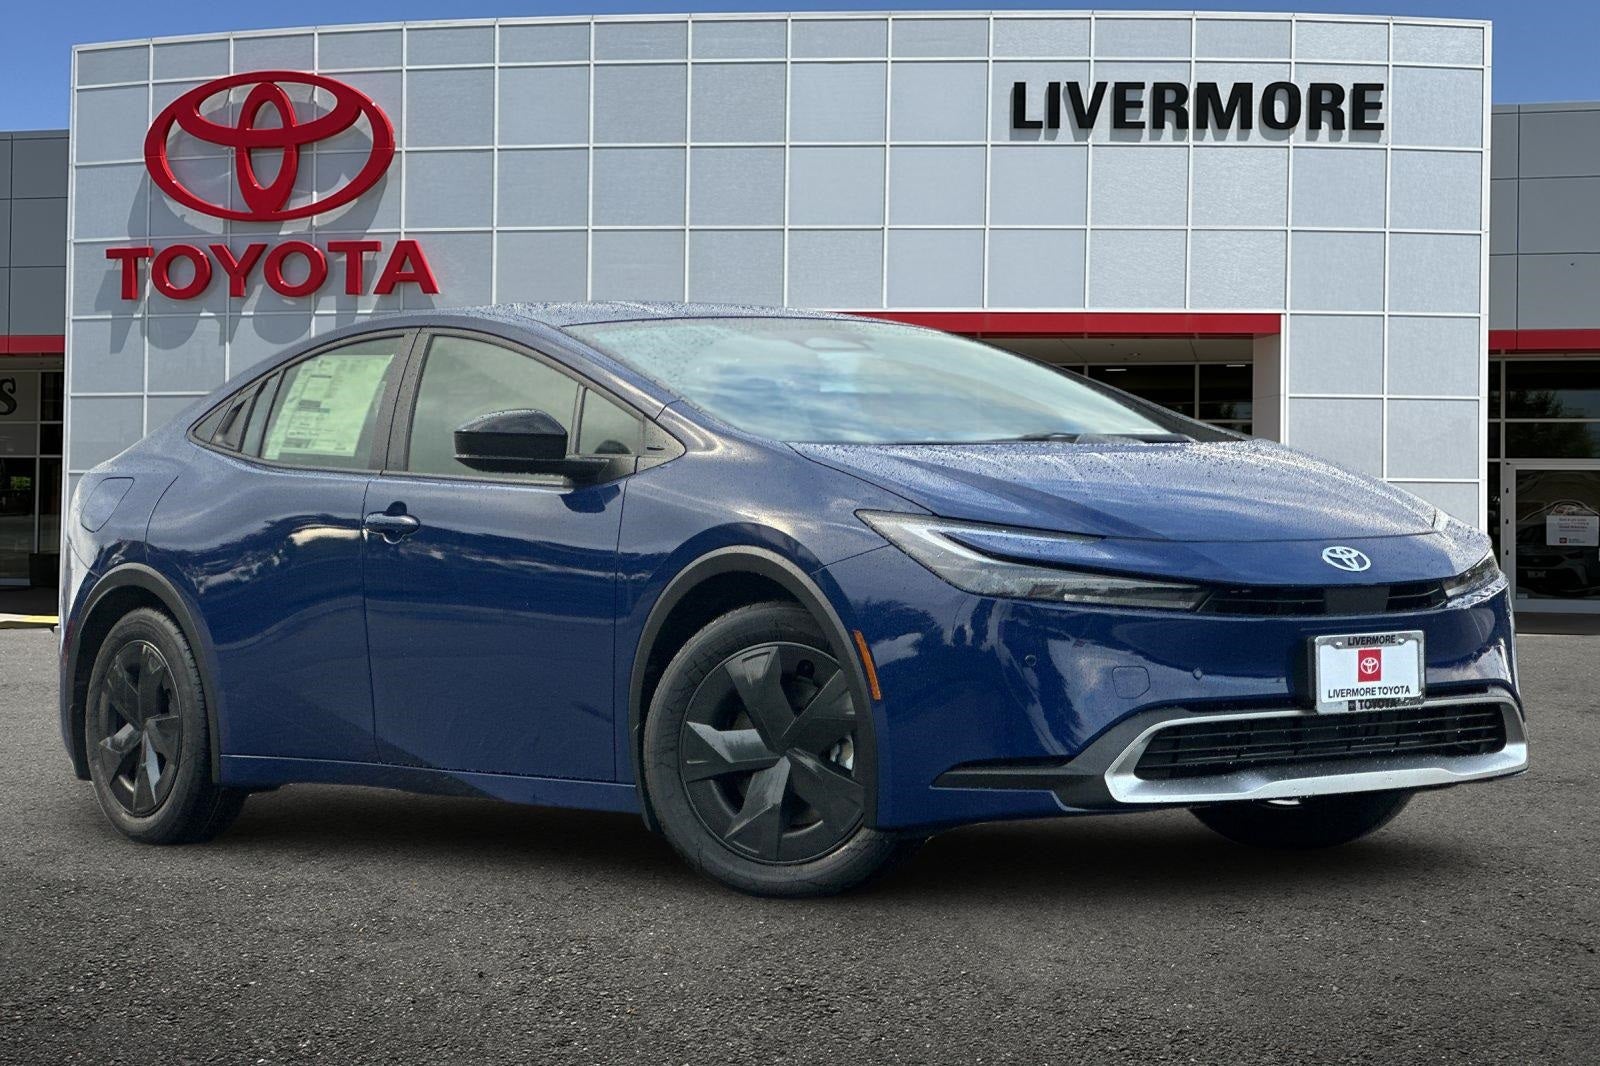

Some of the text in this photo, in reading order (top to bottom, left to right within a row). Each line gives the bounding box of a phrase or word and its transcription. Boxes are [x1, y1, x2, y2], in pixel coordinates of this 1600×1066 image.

[1013, 81, 1385, 131] LIVERMORE
[105, 240, 441, 300] TOYOTA
[1347, 635, 1396, 646] LIVERMORE
[1327, 685, 1411, 699] LIVERMORE TOYOTA
